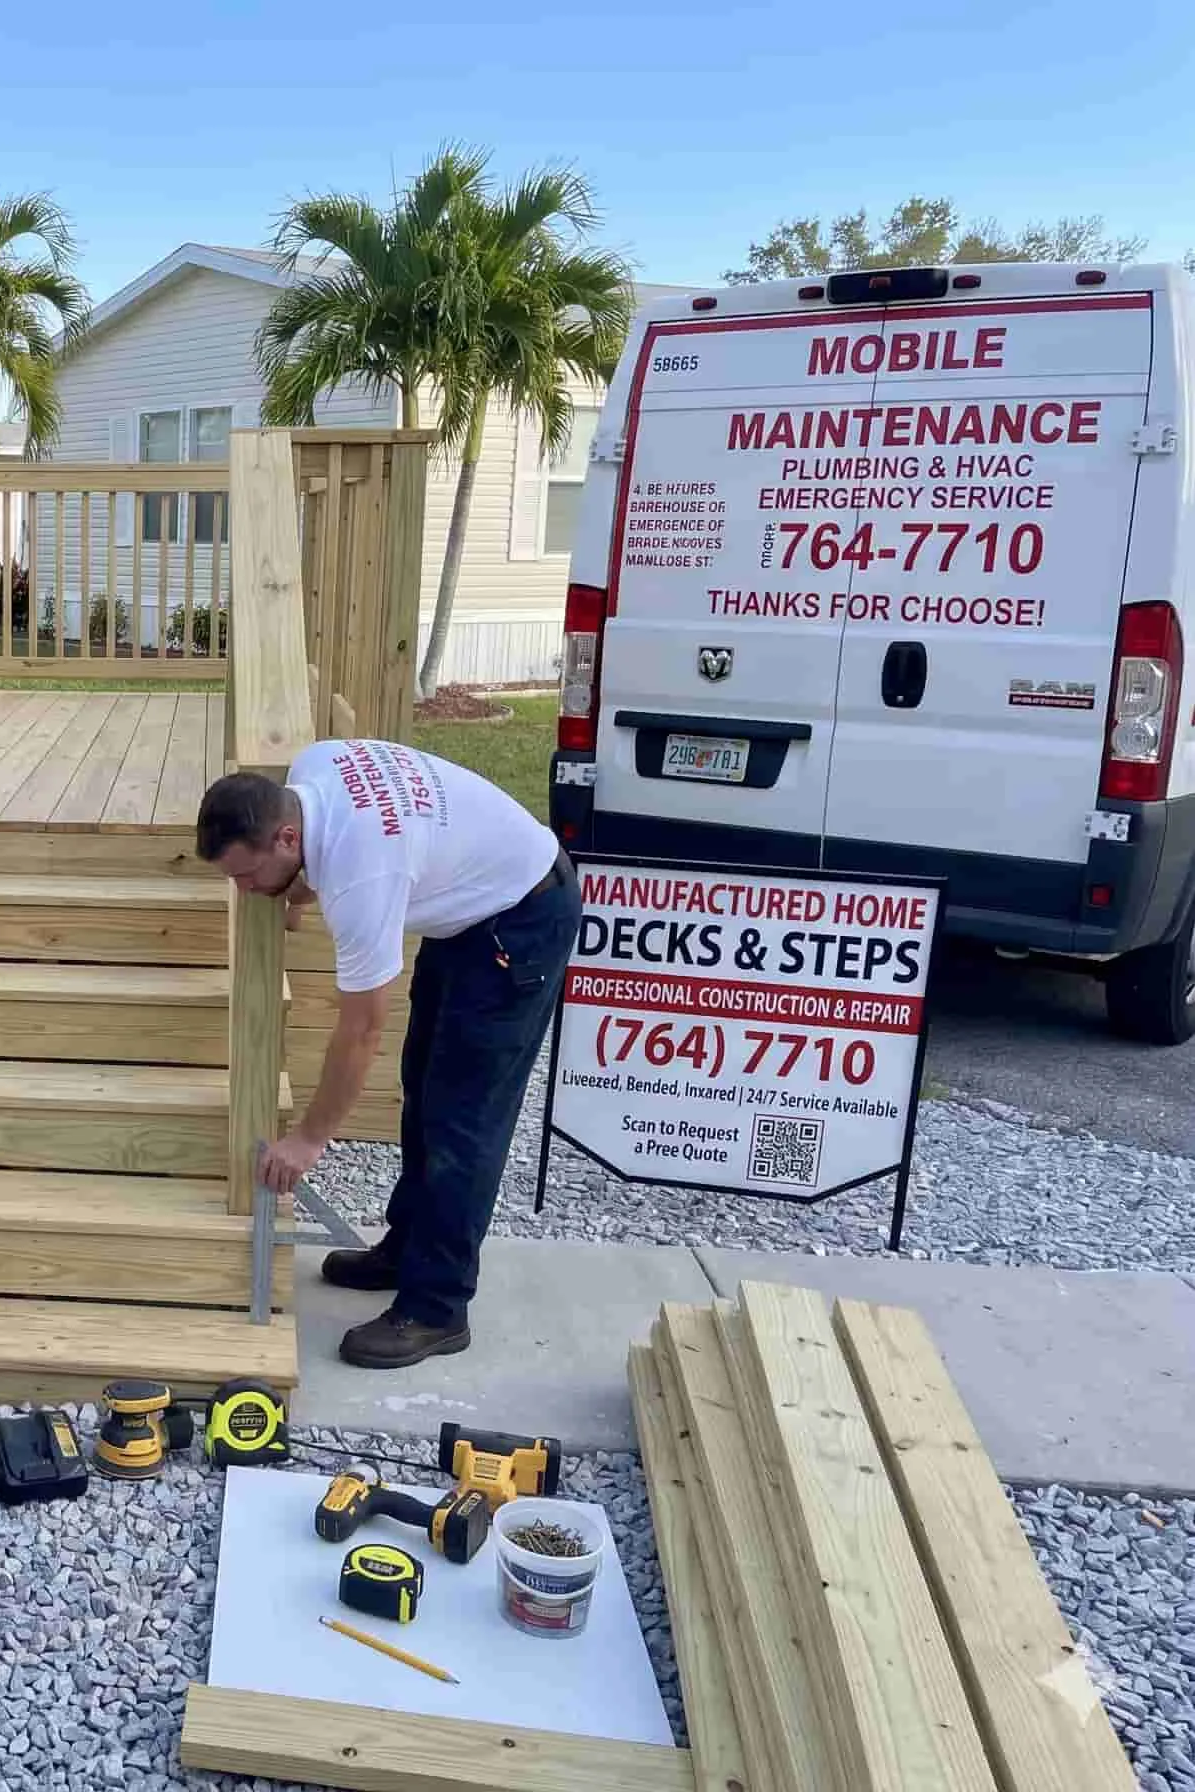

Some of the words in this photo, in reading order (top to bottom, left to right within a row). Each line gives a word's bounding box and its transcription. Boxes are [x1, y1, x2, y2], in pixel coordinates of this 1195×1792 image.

[653, 356, 699, 371] 58665
[807, 328, 1006, 375] MOBILE
[727, 401, 1101, 450] MAINTENANCE
[781, 457, 919, 481] PLUMBING
[928, 456, 947, 478] &
[955, 454, 1034, 479] HVAC
[758, 487, 924, 510] EMERGENCY
[930, 485, 1054, 509] SERVICE
[779, 521, 1044, 575] 764-7710
[707, 590, 820, 619] THANKS
[830, 593, 892, 621] FOR
[900, 595, 1045, 627] CHOOSE!
[333, 755, 372, 809] MOBILE
[581, 874, 825, 922] MANUFACTURED
[834, 894, 927, 930] HOME
[577, 914, 722, 966] DECKS
[734, 927, 766, 971] &
[779, 931, 920, 984] STEPS
[572, 975, 694, 1006] PROFESSIONAL
[699, 987, 830, 1019] CONSTRUCTION
[834, 1003, 846, 1020] &
[850, 1002, 911, 1025] REPAIR
[596, 1015, 725, 1078] (764)
[742, 1030, 875, 1085] 7710
[627, 1076, 680, 1098] Bended,
[746, 1088, 776, 1106] 24/7
[780, 1092, 829, 1112] Service
[833, 1096, 898, 1119] Available
[622, 1115, 655, 1135] Scan
[660, 1120, 674, 1135] to
[678, 1120, 739, 1143] Request
[634, 1143, 642, 1155] a
[683, 1144, 728, 1162] Quote
